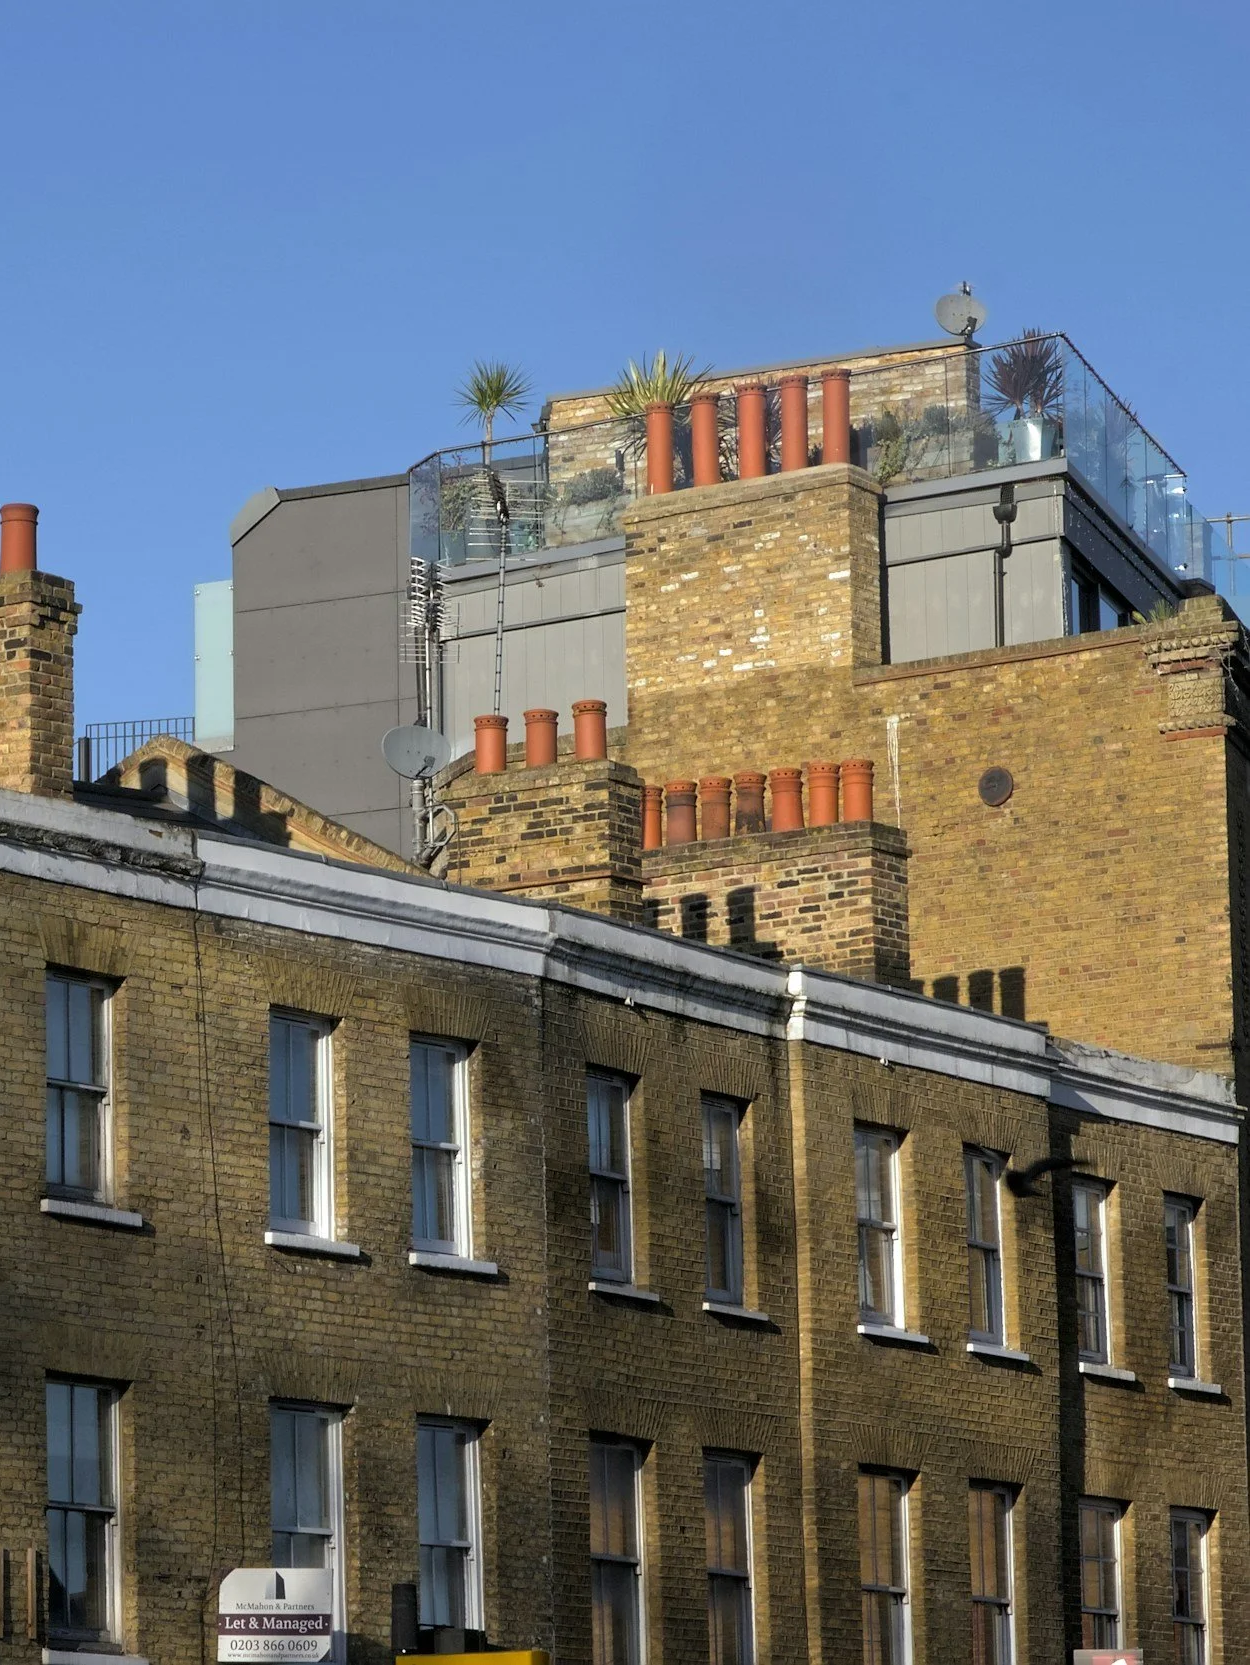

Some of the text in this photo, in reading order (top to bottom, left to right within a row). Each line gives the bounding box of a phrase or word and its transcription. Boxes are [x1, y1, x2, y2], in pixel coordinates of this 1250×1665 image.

[235, 1602, 274, 1611] McMahon
[283, 1602, 315, 1611] Partners
[225, 1616, 323, 1634] Let & Managed
[230, 1639, 318, 1652] 0203 866 0609
